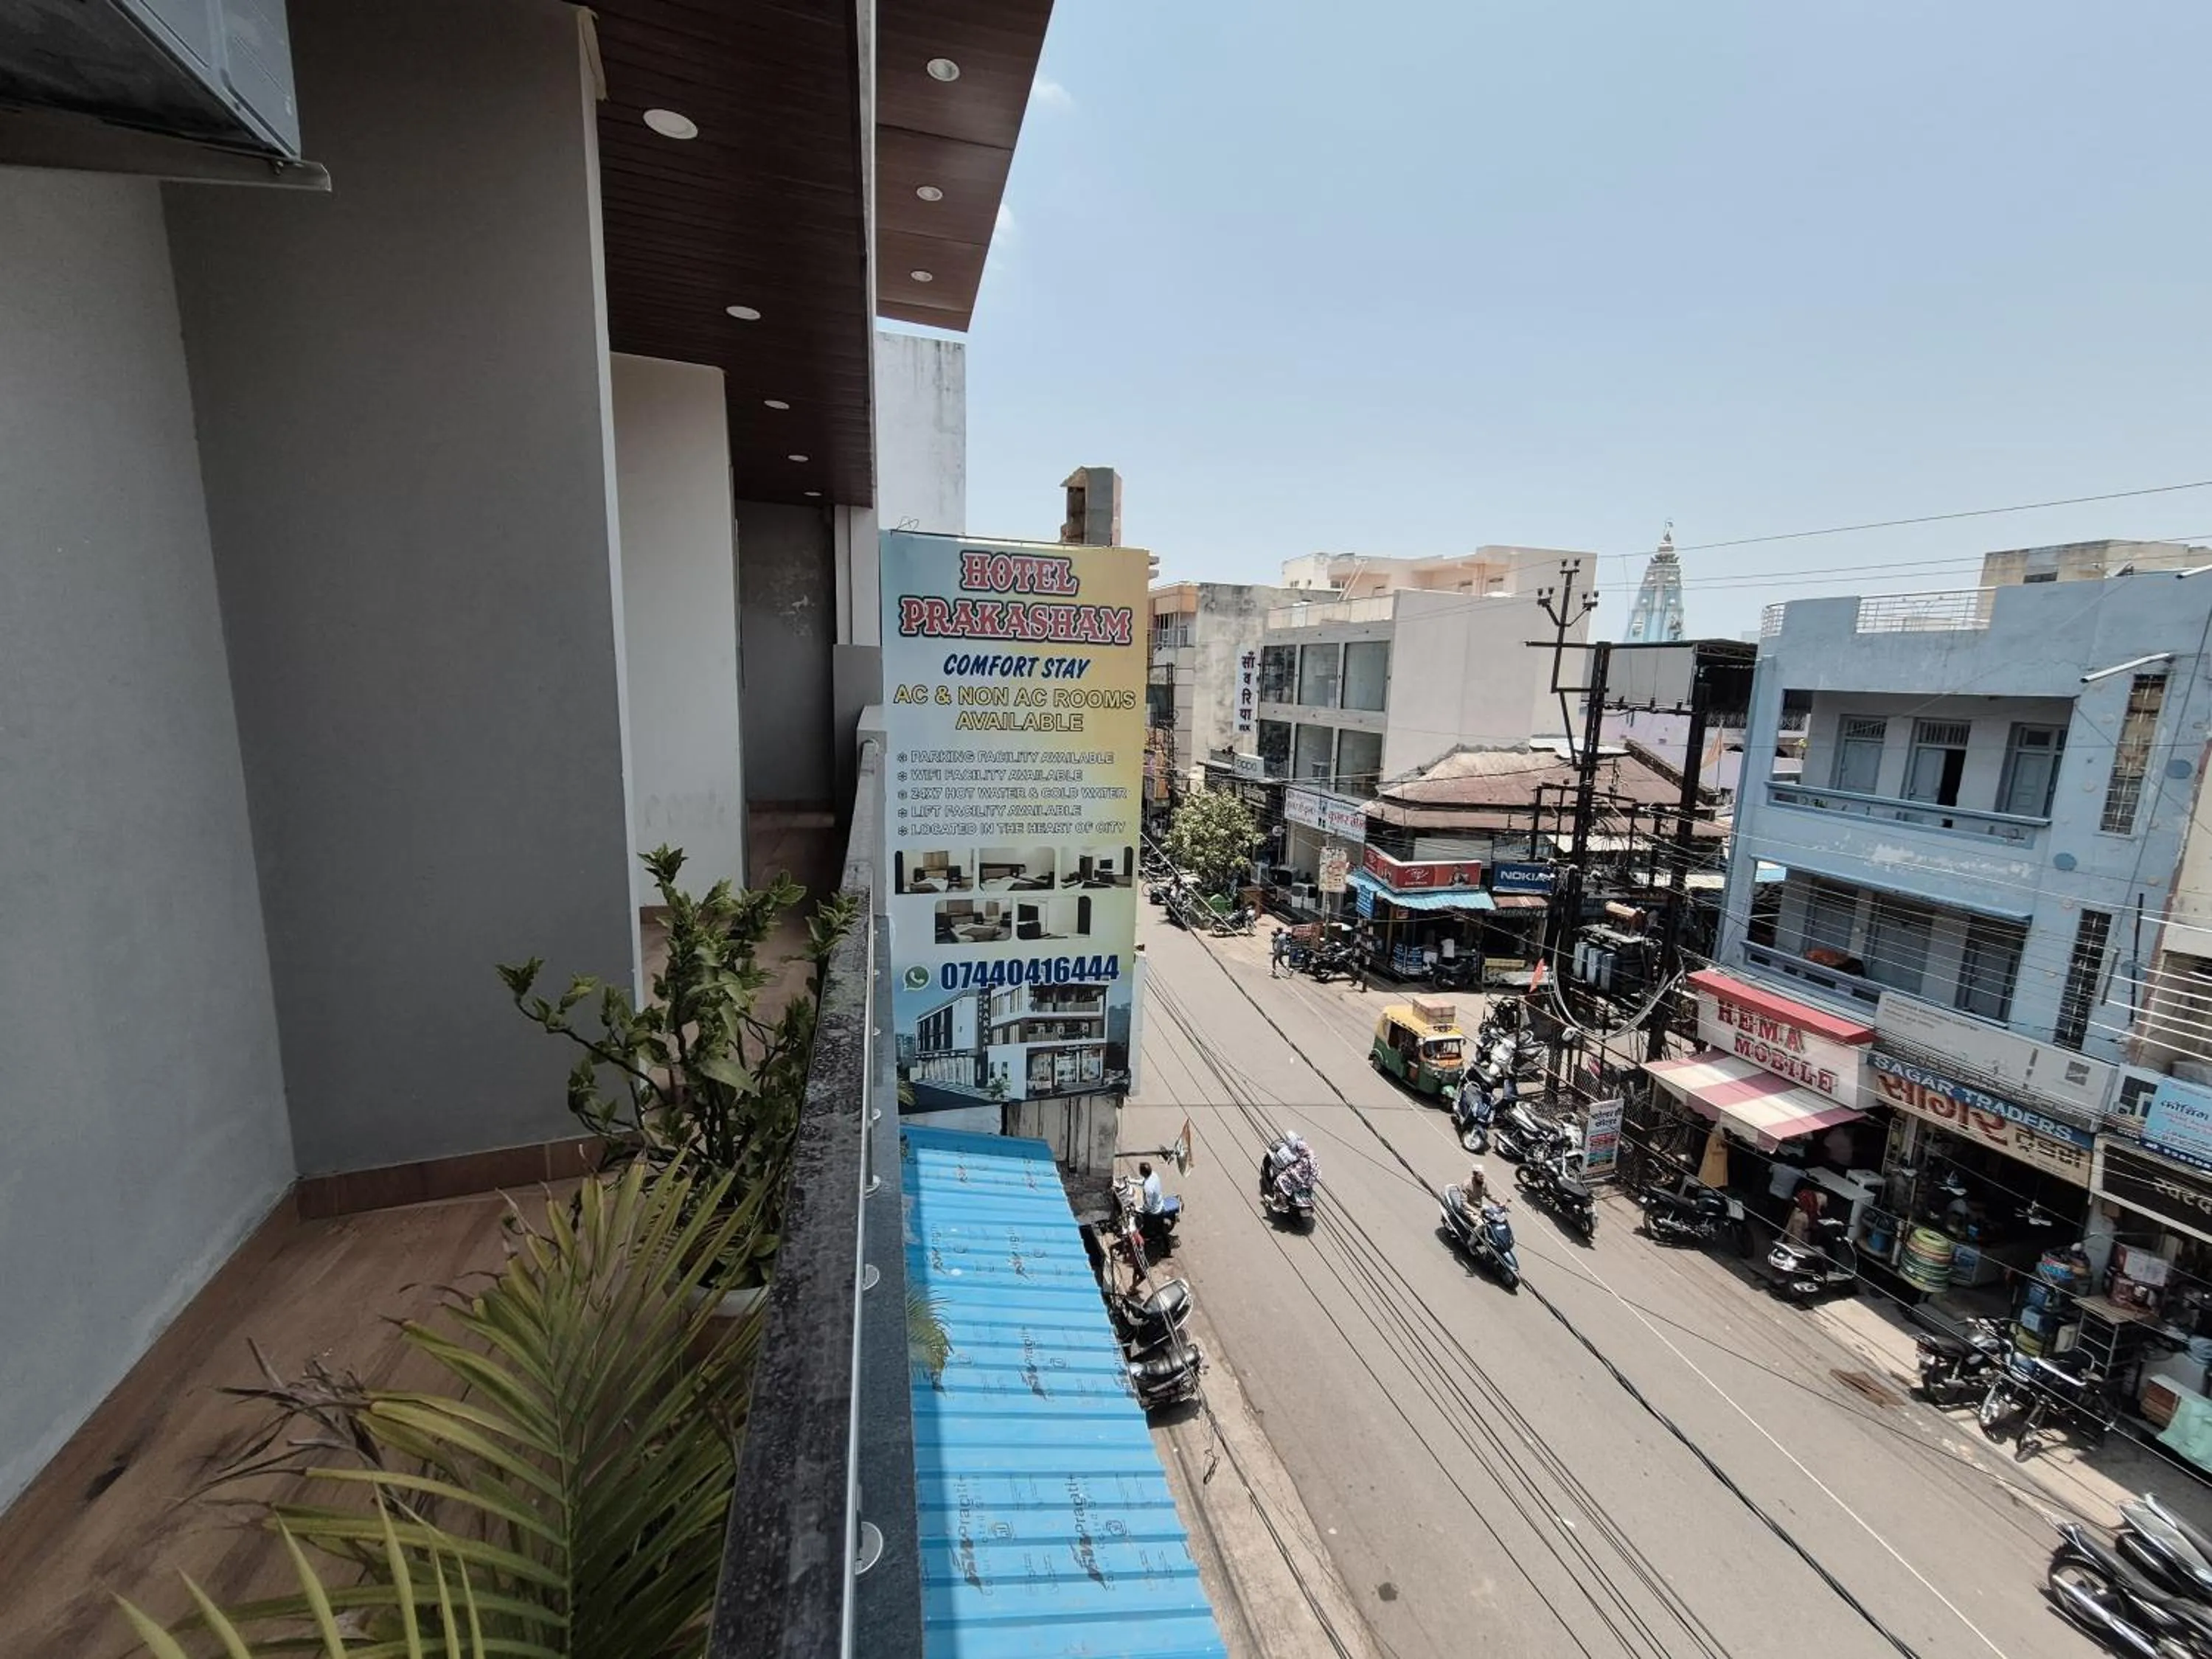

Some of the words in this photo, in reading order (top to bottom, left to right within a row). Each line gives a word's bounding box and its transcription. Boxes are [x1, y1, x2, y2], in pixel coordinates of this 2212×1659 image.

[959, 551, 1079, 596] HOTEL
[899, 595, 1133, 644] PRAKASHAM
[943, 654, 1040, 677] COMFORT
[1042, 656, 1091, 678] STAY
[894, 685, 928, 703] AC
[934, 686, 952, 704] &
[959, 686, 1009, 706] NON
[1014, 688, 1047, 708] AC
[1054, 689, 1135, 709] ROOMS
[956, 712, 1084, 731] AVAILABLE
[911, 751, 975, 762] PARKING
[978, 751, 1038, 763] FACILITY
[1040, 752, 1114, 764] AVAILABLE
[911, 769, 941, 781] WIFI
[945, 769, 1006, 781] FACILITY
[1008, 770, 1082, 782] AVAILABLE
[945, 787, 975, 799] HOT
[978, 787, 1025, 799] WATER
[1029, 787, 1038, 799] &
[1041, 787, 1079, 799] COLD
[1082, 787, 1127, 799] WATER
[911, 805, 942, 817] LIFT
[945, 805, 1006, 817] FACILITY
[1007, 805, 1082, 816] AVAILABLE
[911, 823, 976, 835] LOCATED
[980, 823, 994, 835] IN
[997, 822, 1023, 835] THE
[1028, 822, 1072, 834] HEART
[1075, 821, 1093, 833] OF
[1095, 821, 1126, 833] CITY
[940, 955, 1120, 990] 07440416444
[1718, 1001, 1805, 1053] HEMA
[1734, 1032, 1837, 1094] MOBILE
[1874, 1056, 1955, 1097] SAGAR
[1962, 1088, 2073, 1141] TRADERS
[1877, 1074, 2008, 1146] सागर
